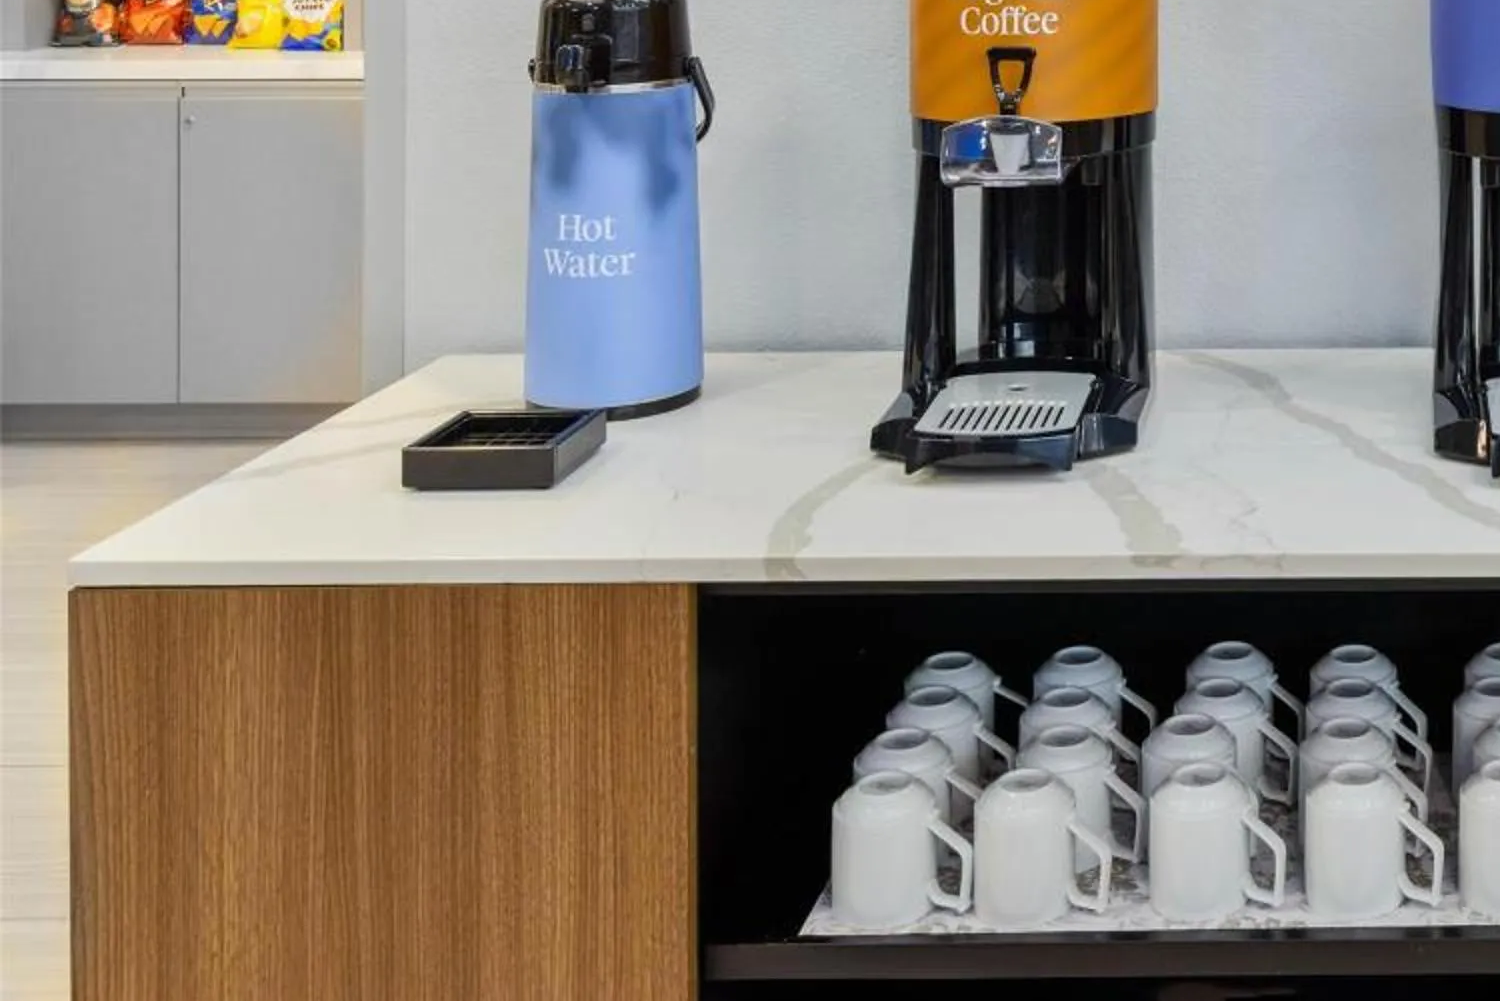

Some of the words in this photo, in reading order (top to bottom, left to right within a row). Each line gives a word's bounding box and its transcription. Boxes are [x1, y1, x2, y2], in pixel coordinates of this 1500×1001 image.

[960, 6, 1059, 35] Coffee
[559, 214, 617, 242] Hot
[544, 247, 637, 278] Water
